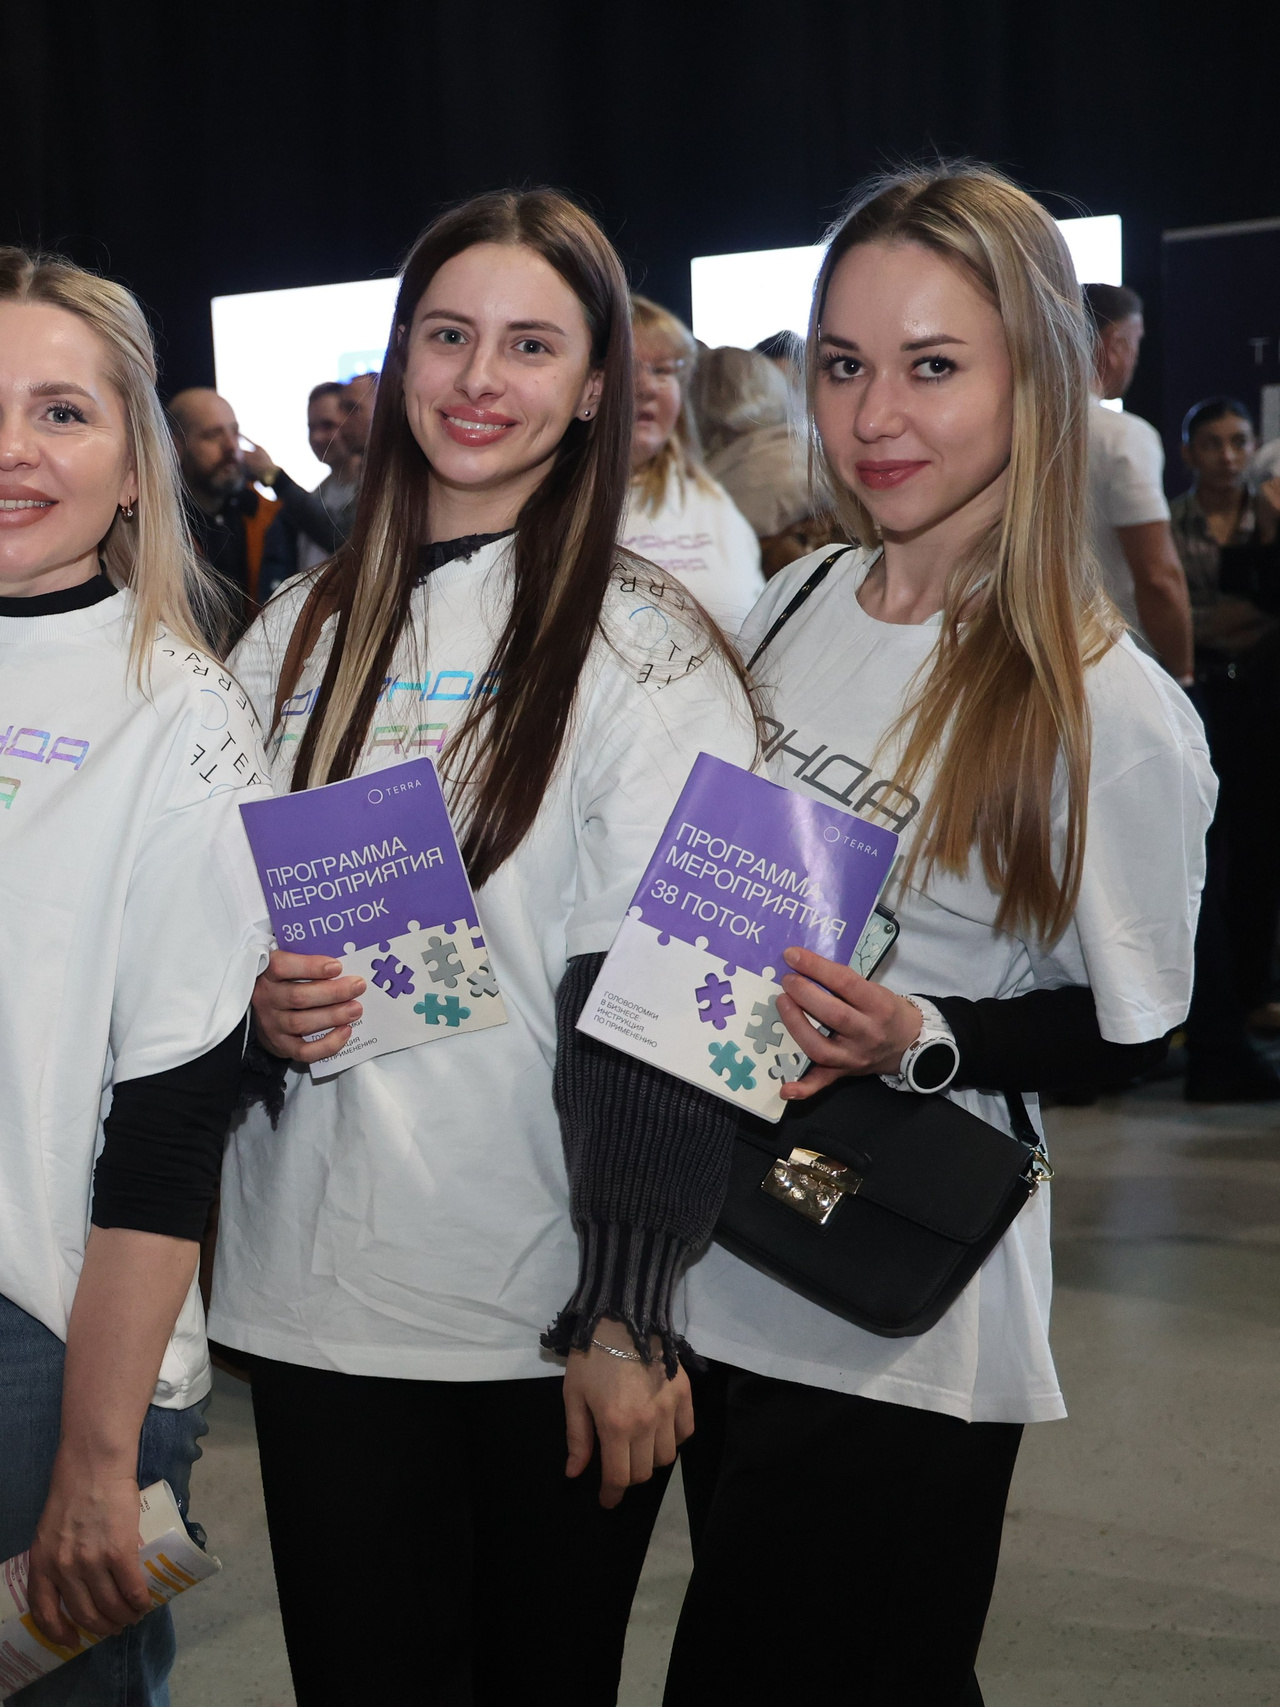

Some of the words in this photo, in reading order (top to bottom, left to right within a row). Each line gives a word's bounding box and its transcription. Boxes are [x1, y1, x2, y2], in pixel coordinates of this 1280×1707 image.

[386, 779, 422, 796] TERRA
[266, 836, 407, 888] ПРОГРАММА
[676, 822, 820, 903] ПРОГРАММА
[843, 836, 878, 857] TERRA
[272, 847, 444, 910] МЕРОПРИЯТИЯ
[665, 845, 847, 941] МЕРОПРИЯТИЯ
[282, 922, 306, 943] 38
[310, 898, 390, 937] ПОТОК
[650, 879, 679, 905] 38
[681, 892, 766, 944] ПОТОК
[597, 1007, 645, 1032] ИНСТРУКЦИЯ
[600, 998, 607, 1006] В
[603, 991, 659, 1020] ГОЛОВОЛОМКИ
[593, 1014, 605, 1024] ПО
[605, 1020, 658, 1048] ПРИМЕНЕНИЮ
